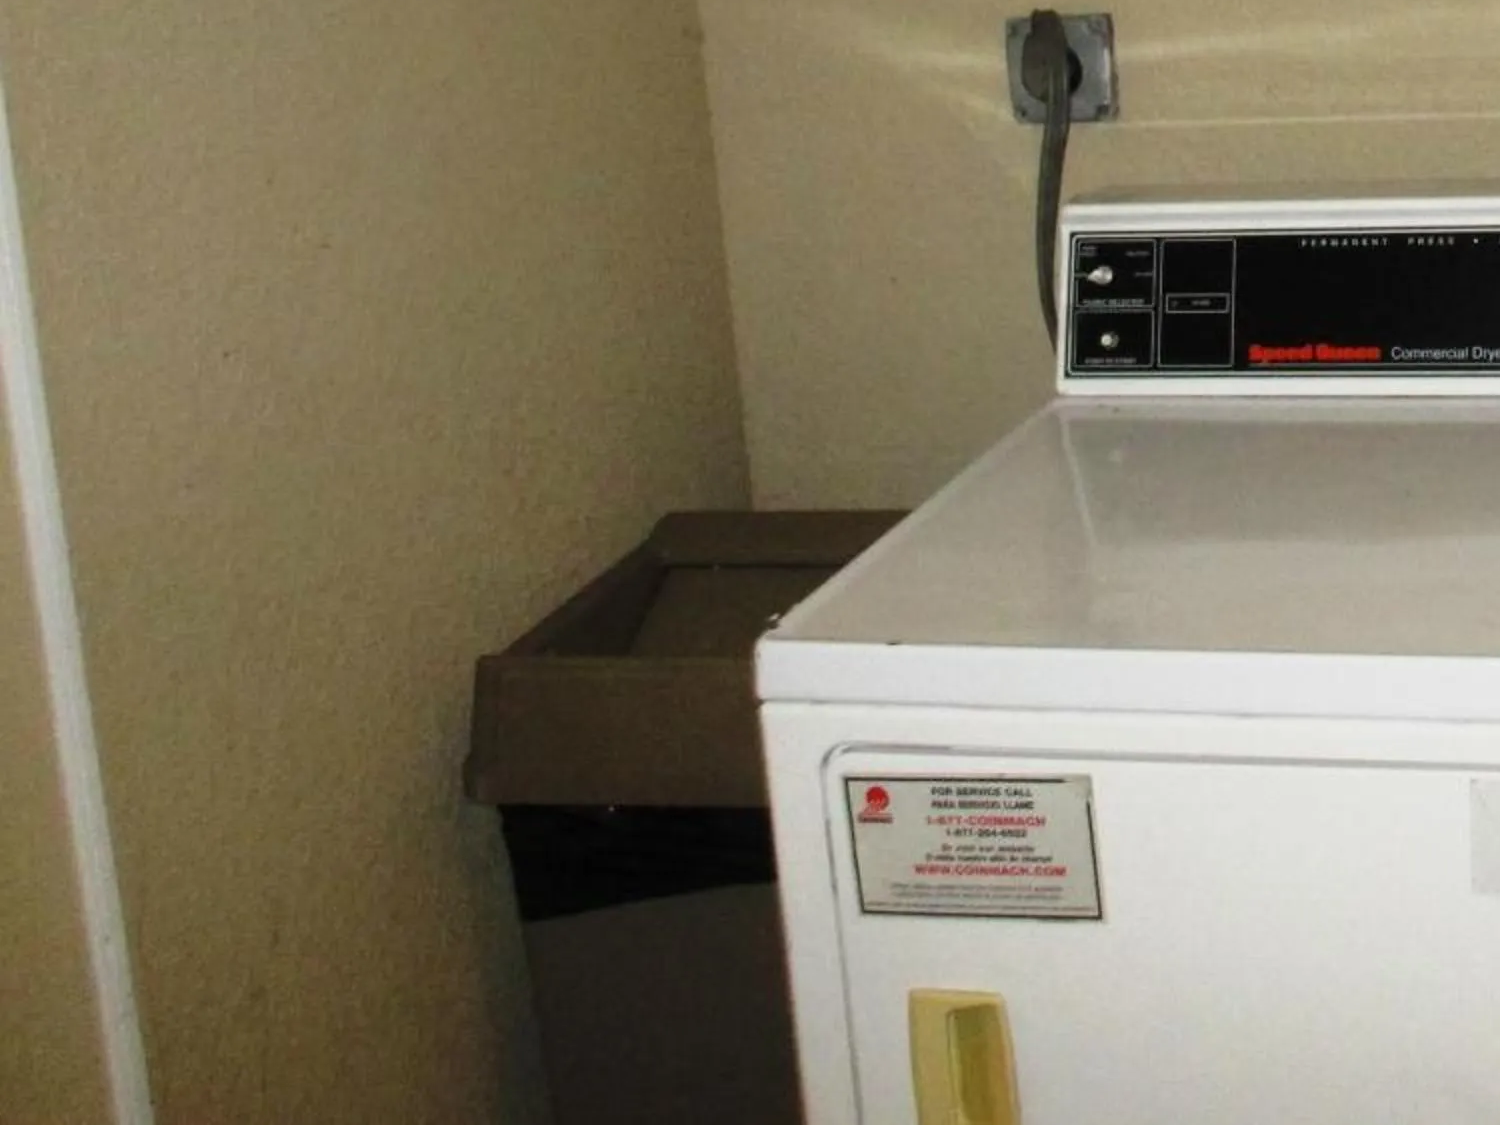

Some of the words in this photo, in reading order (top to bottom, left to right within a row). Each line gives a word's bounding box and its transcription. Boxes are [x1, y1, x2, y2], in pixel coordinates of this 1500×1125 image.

[1300, 236, 1389, 248] PERMANENT
[1407, 236, 1456, 247] PRESS
[1248, 343, 1314, 364] Speed
[1315, 343, 1382, 362] Queen
[1390, 346, 1469, 361] Commercial
[931, 786, 953, 796] FOR
[956, 786, 1002, 797] SERVICE
[1004, 787, 1033, 797] CALL
